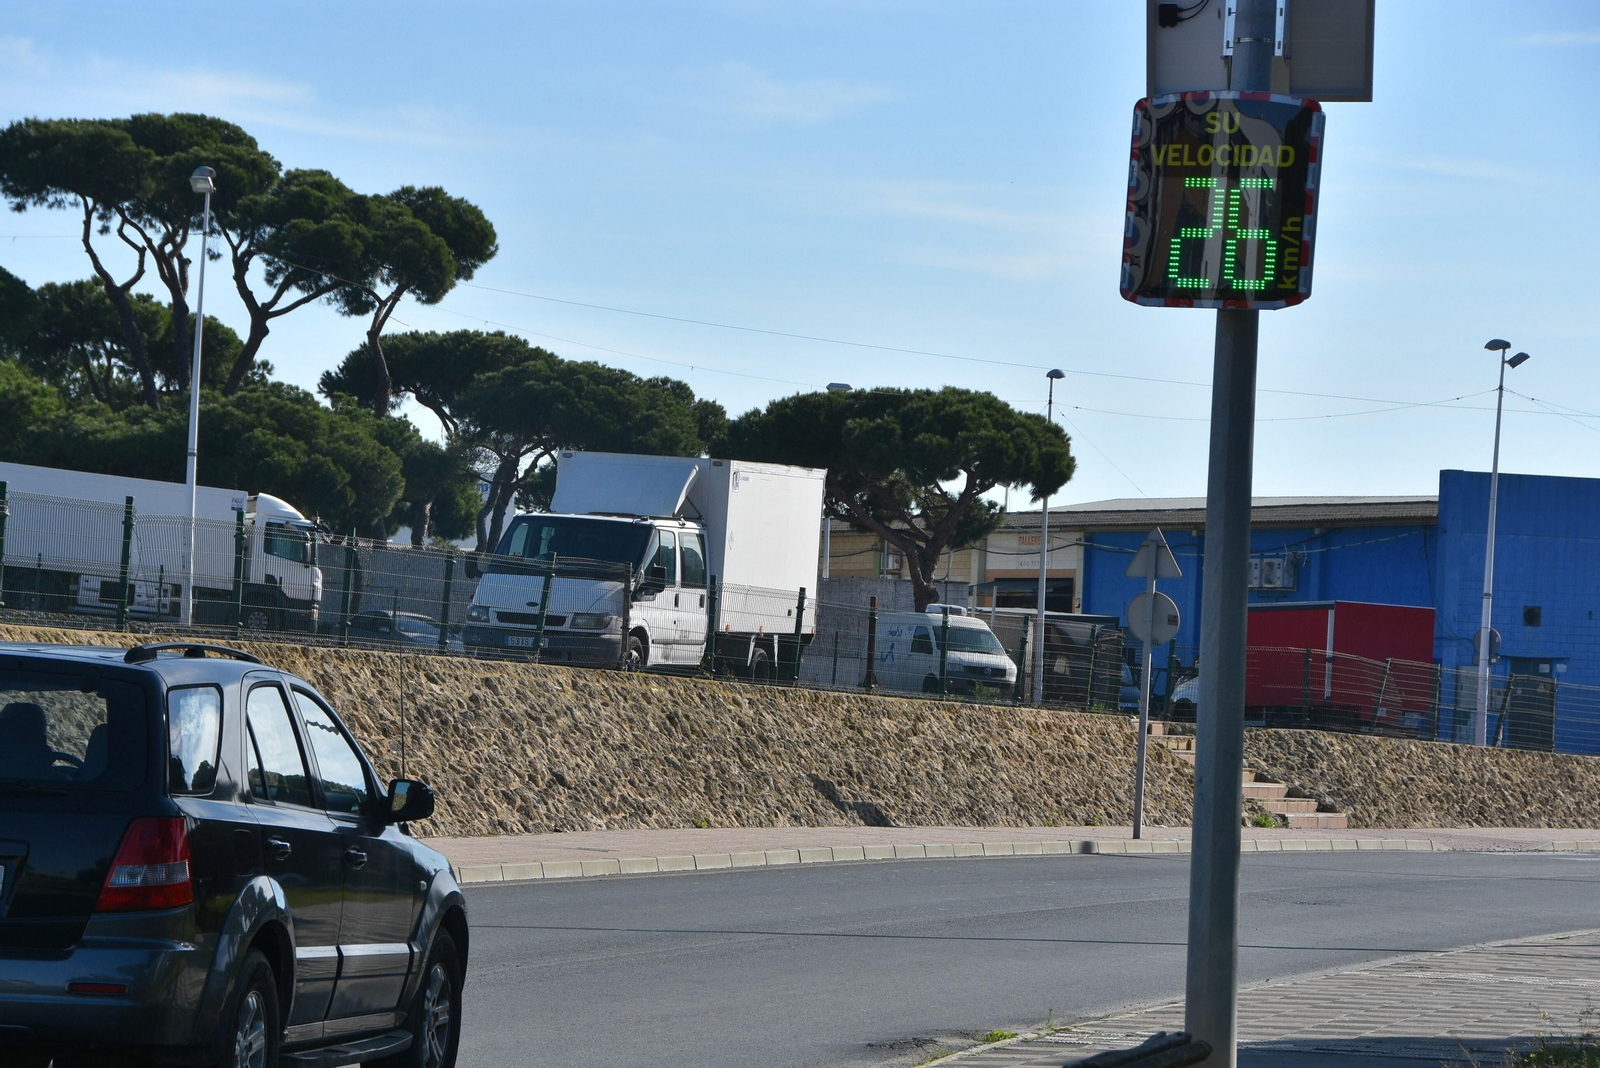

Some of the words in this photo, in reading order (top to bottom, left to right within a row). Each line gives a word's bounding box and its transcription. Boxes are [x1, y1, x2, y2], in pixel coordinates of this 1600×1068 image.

[1205, 112, 1241, 134] SU
[1152, 144, 1295, 168] VELOCIDAD
[1168, 177, 1276, 290] 26
[1277, 216, 1302, 290] km/h
[1019, 535, 1042, 546] TALLERE
